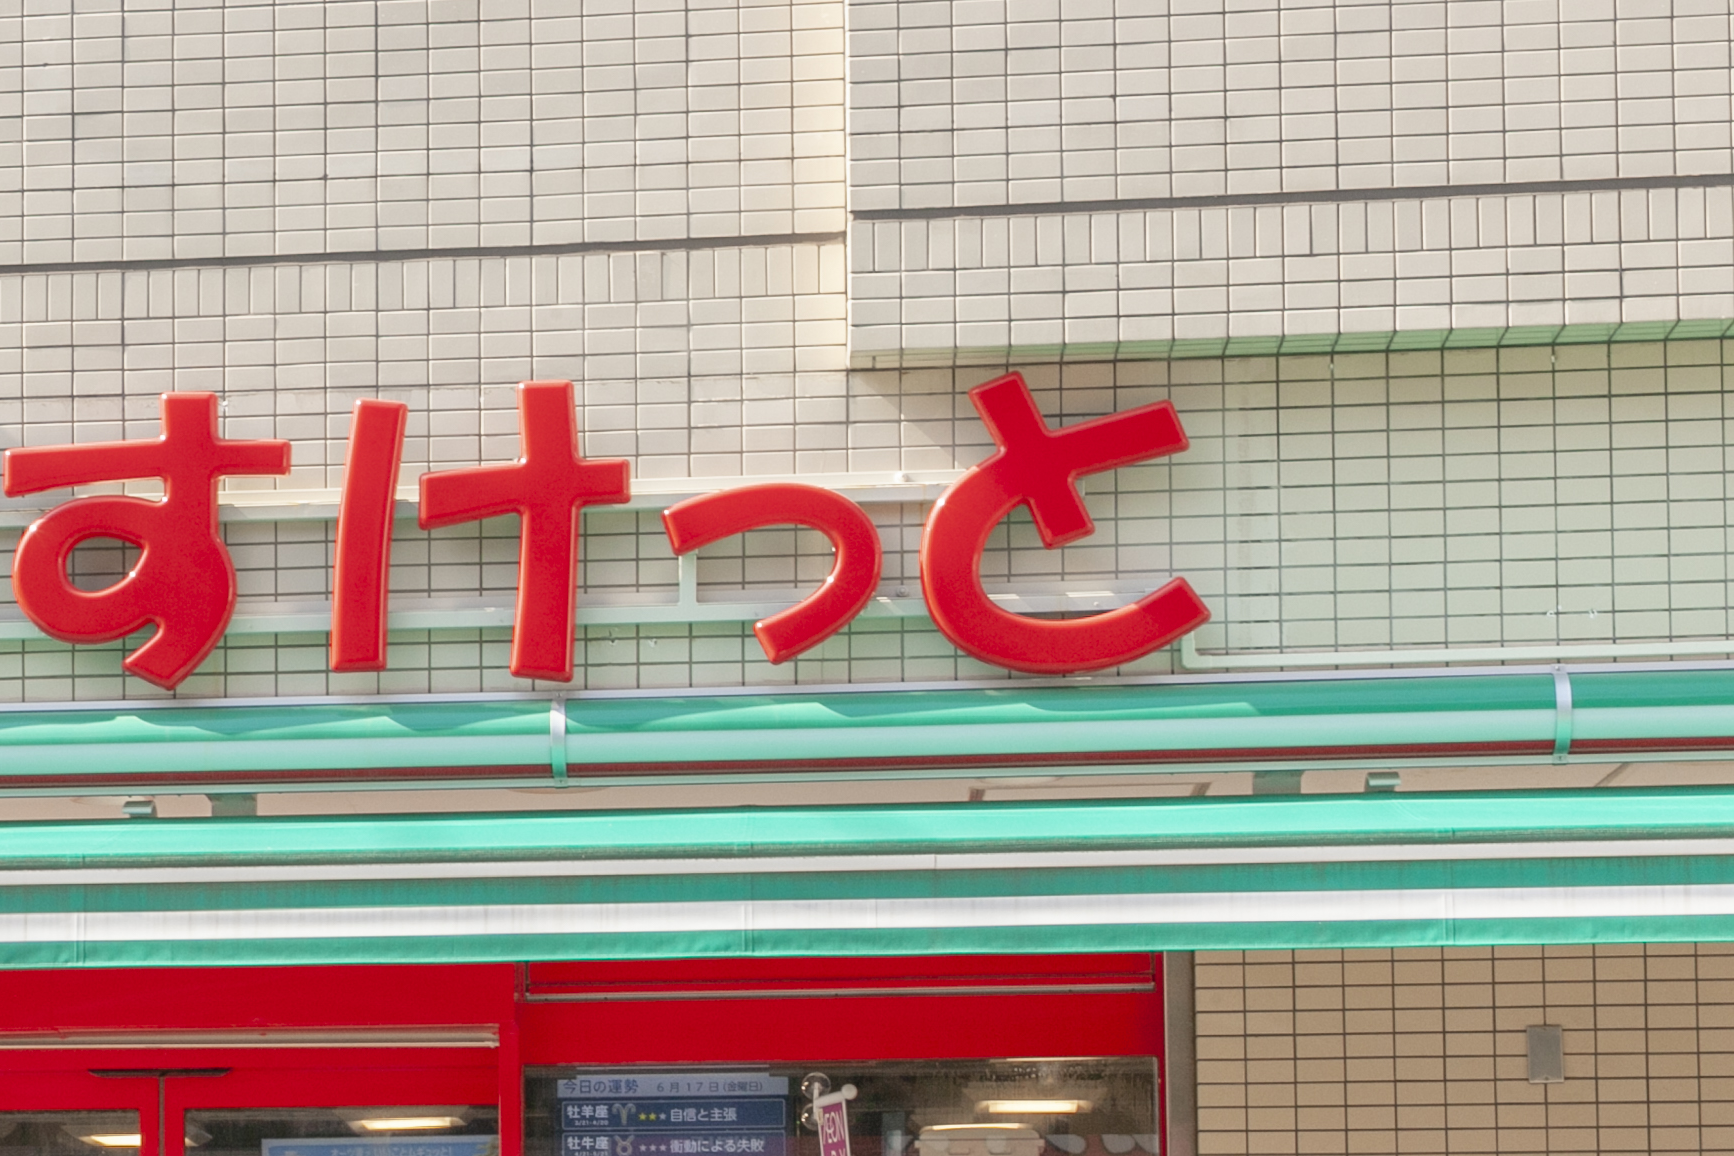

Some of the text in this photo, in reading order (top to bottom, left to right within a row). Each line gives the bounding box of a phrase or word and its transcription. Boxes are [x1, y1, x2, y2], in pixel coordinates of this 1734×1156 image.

[563, 1080, 639, 1094] 今日の運勢
[567, 1105, 737, 1122] 牡羊座 自信と主張
[567, 1136, 764, 1153] 牡牛座 衝動による失敗
